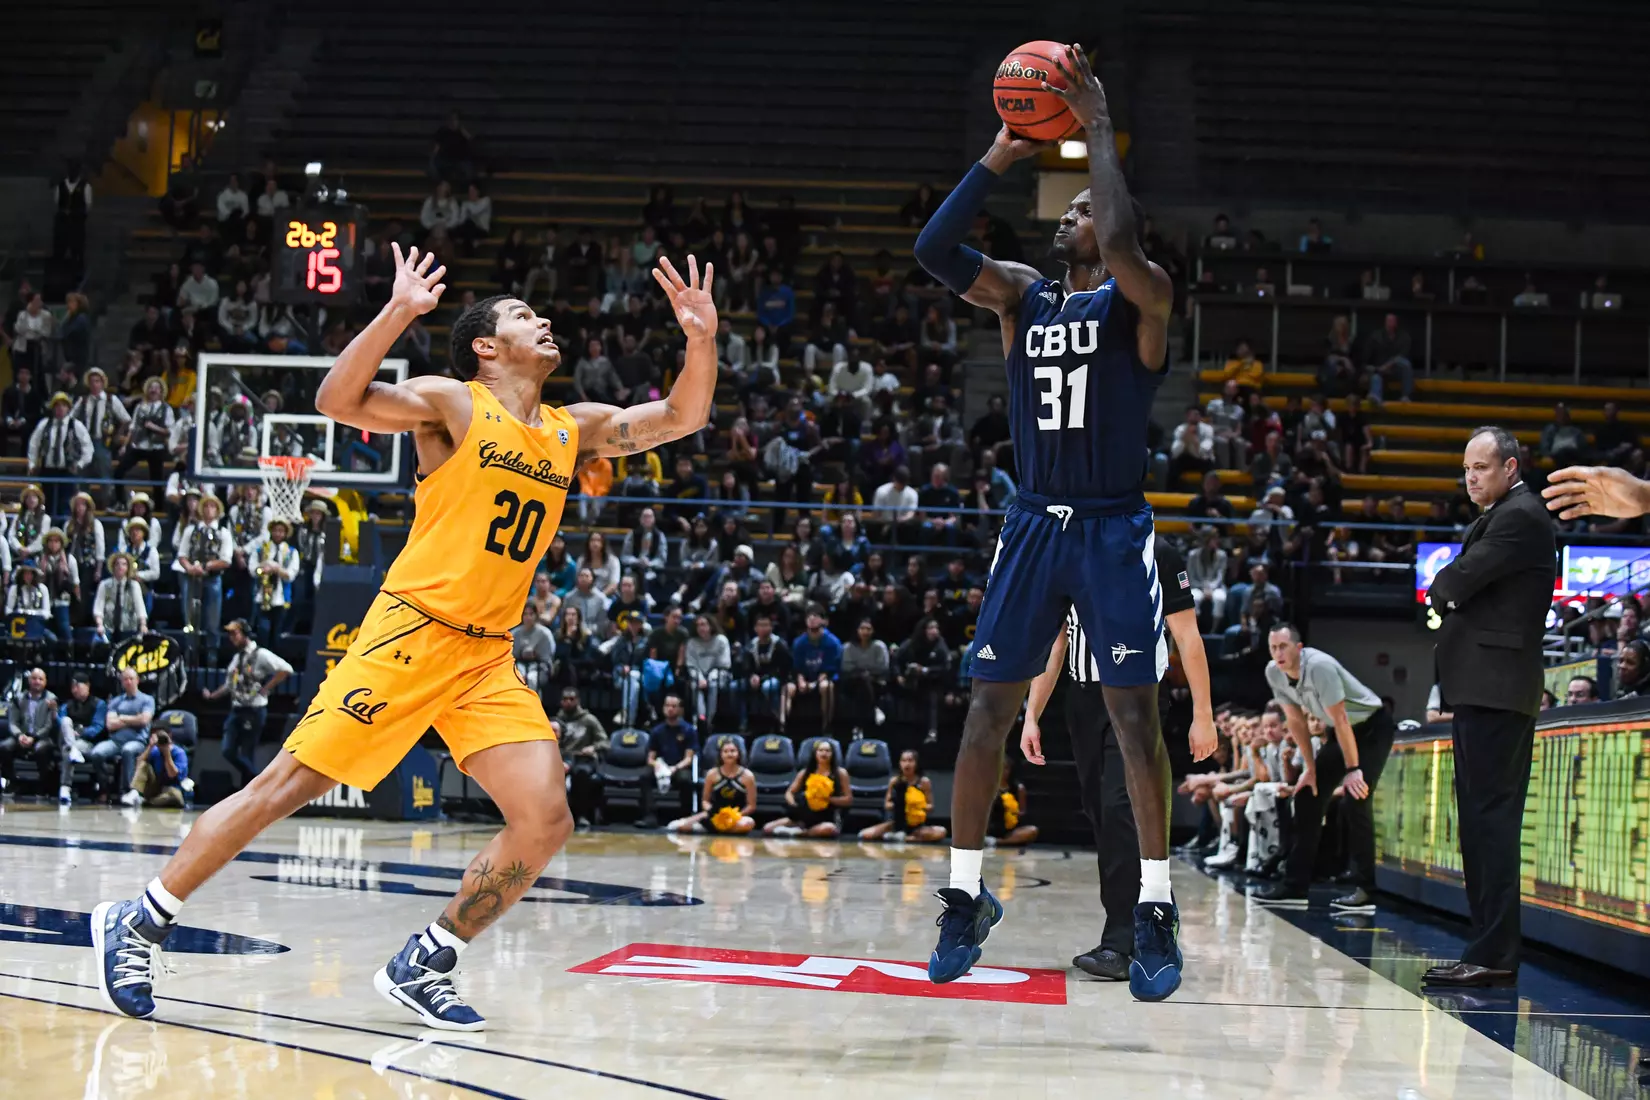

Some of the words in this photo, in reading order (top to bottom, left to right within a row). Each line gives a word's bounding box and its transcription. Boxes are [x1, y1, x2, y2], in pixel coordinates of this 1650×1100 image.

[998, 96, 1035, 112] NCAA
[307, 248, 342, 293] 15
[1025, 320, 1099, 358] CBU
[1033, 364, 1088, 431] 31
[479, 440, 533, 474] Golden
[485, 489, 546, 563] 20
[1576, 556, 1612, 584] 37
[10, 617, 26, 639] C
[337, 687, 388, 725] Cal
